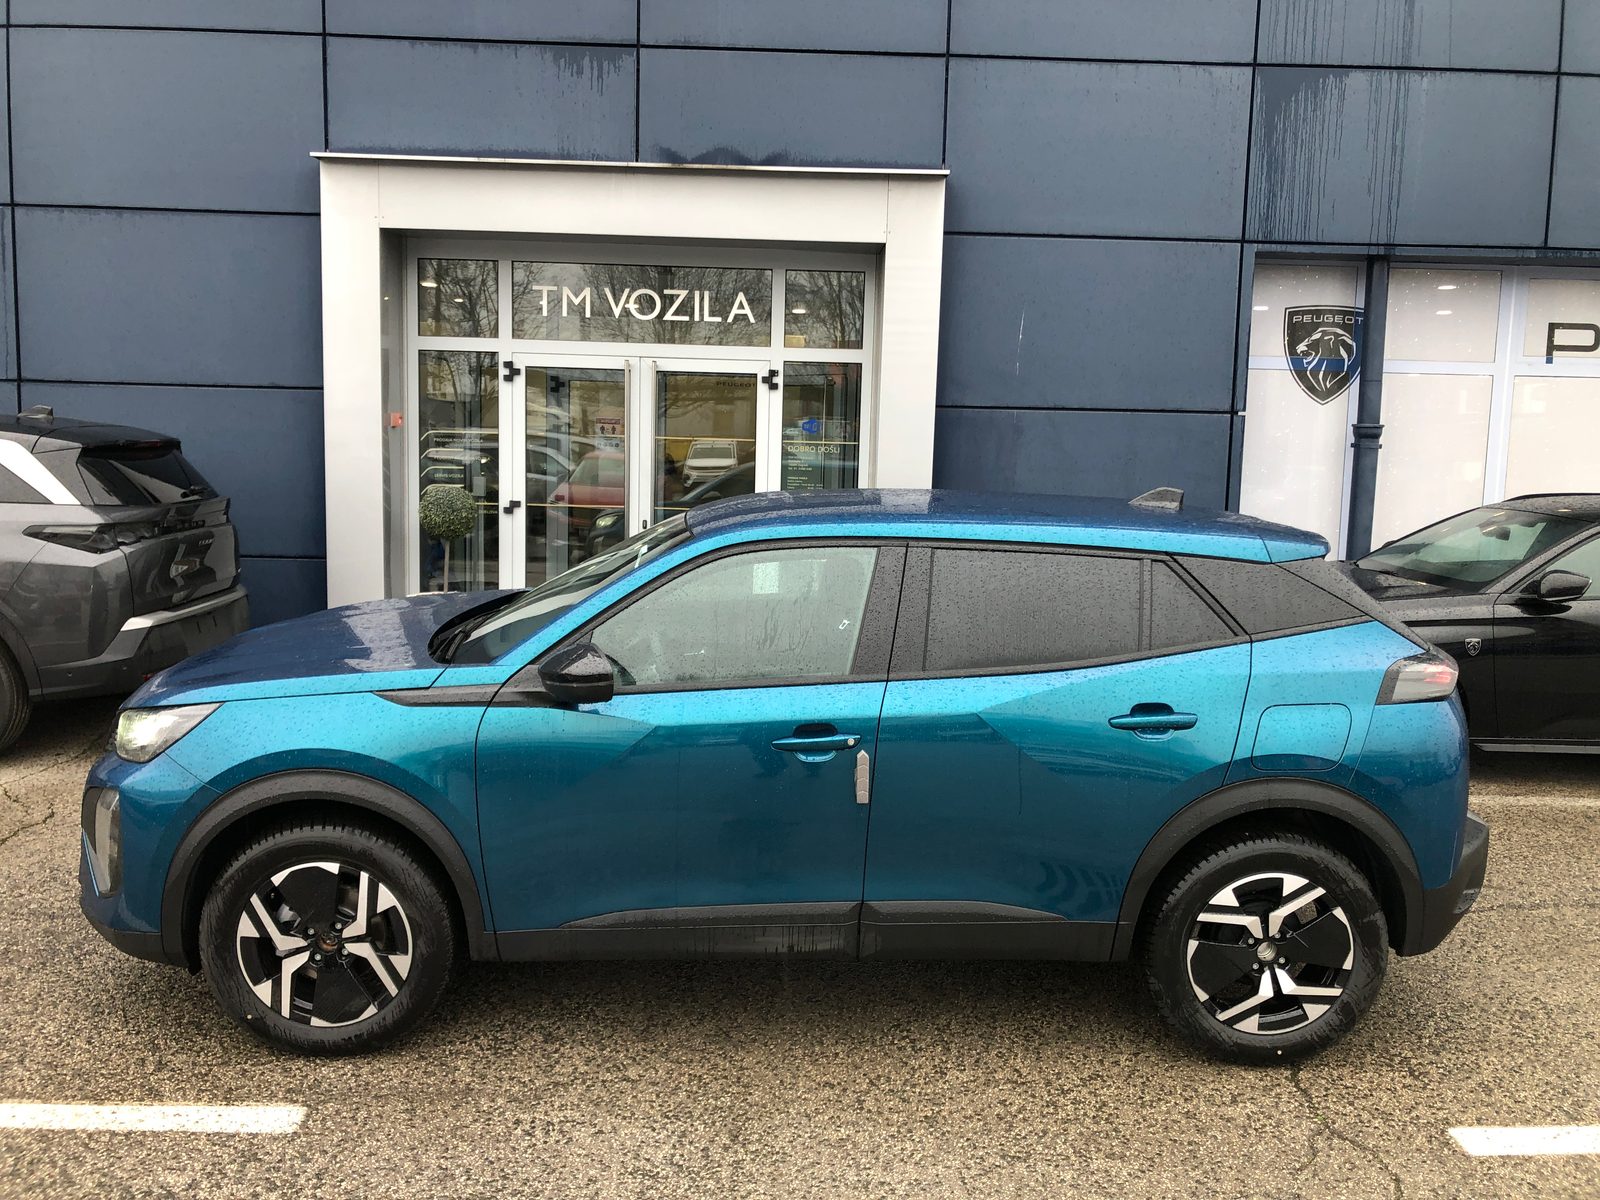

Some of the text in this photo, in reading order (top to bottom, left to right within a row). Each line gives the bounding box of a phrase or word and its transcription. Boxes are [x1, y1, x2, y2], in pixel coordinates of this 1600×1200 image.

[532, 285, 756, 324] TM VOZILA
[1292, 314, 1364, 325] PEUGEOT
[1545, 322, 1600, 365] P
[787, 444, 840, 454] DOBRO DOŠLI
